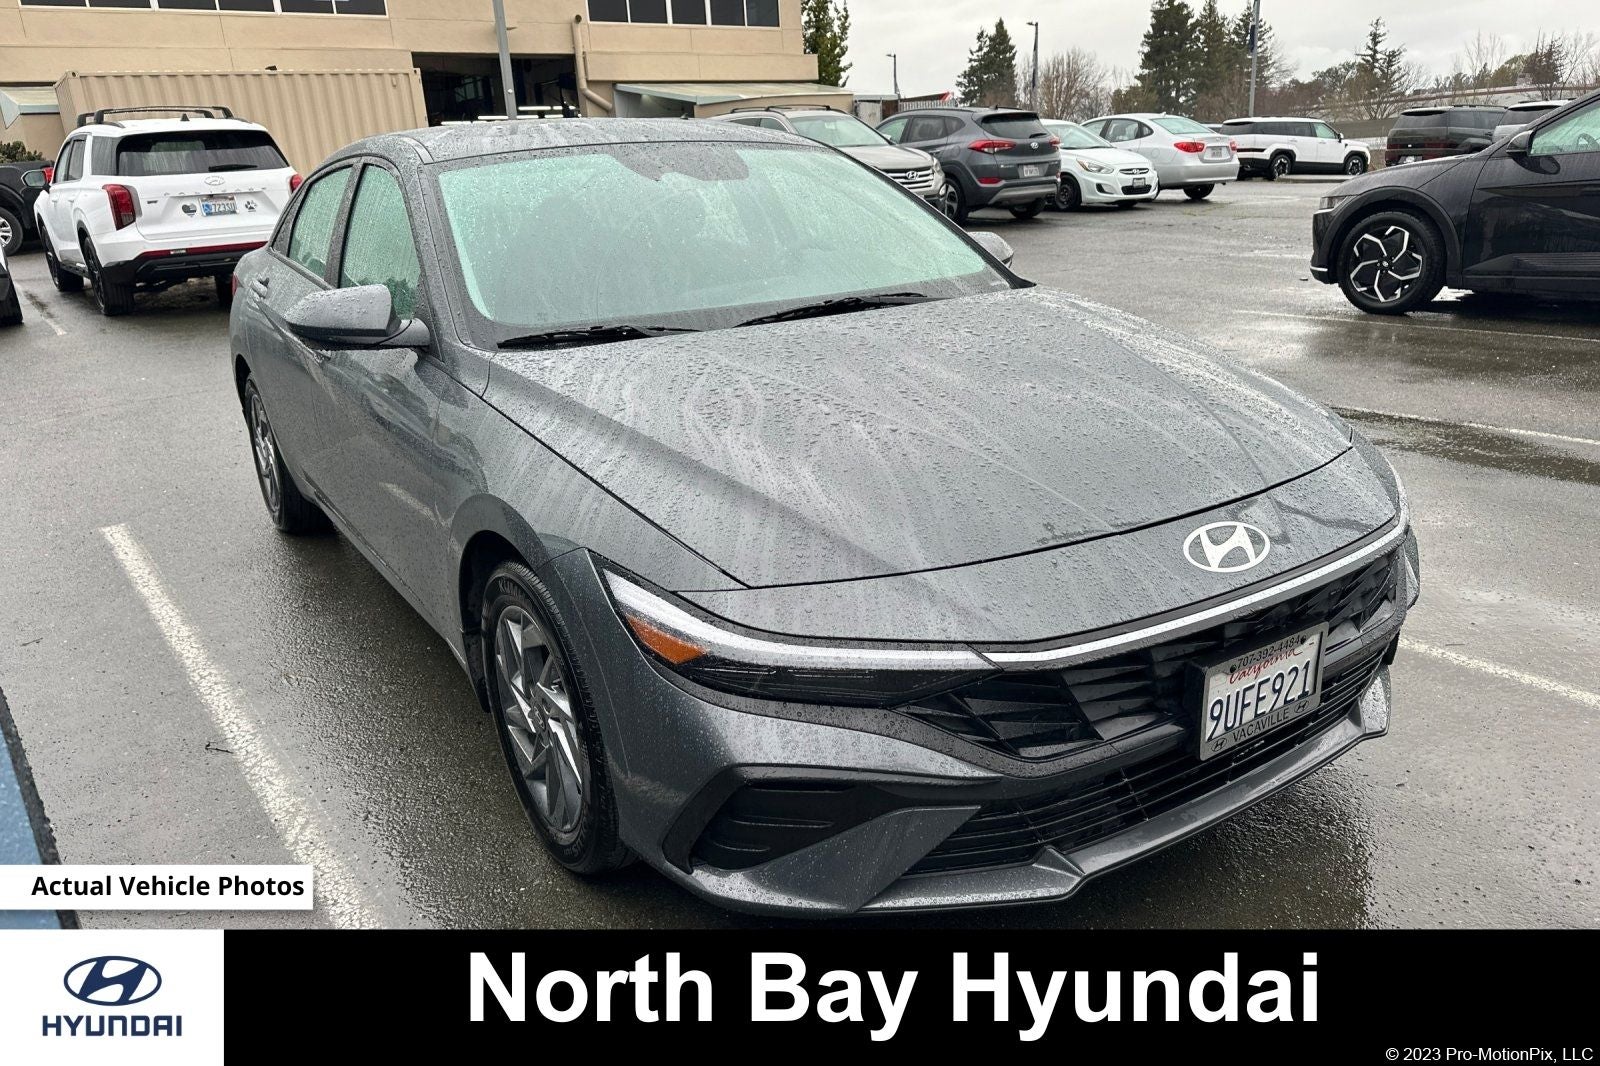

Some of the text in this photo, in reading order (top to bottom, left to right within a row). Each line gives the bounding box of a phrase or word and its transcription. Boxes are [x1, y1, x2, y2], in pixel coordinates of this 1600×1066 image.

[1238, 635, 1300, 669] 707-392-4484
[1206, 660, 1311, 742] 9UFE921
[1233, 708, 1290, 742] VACAVILLE
